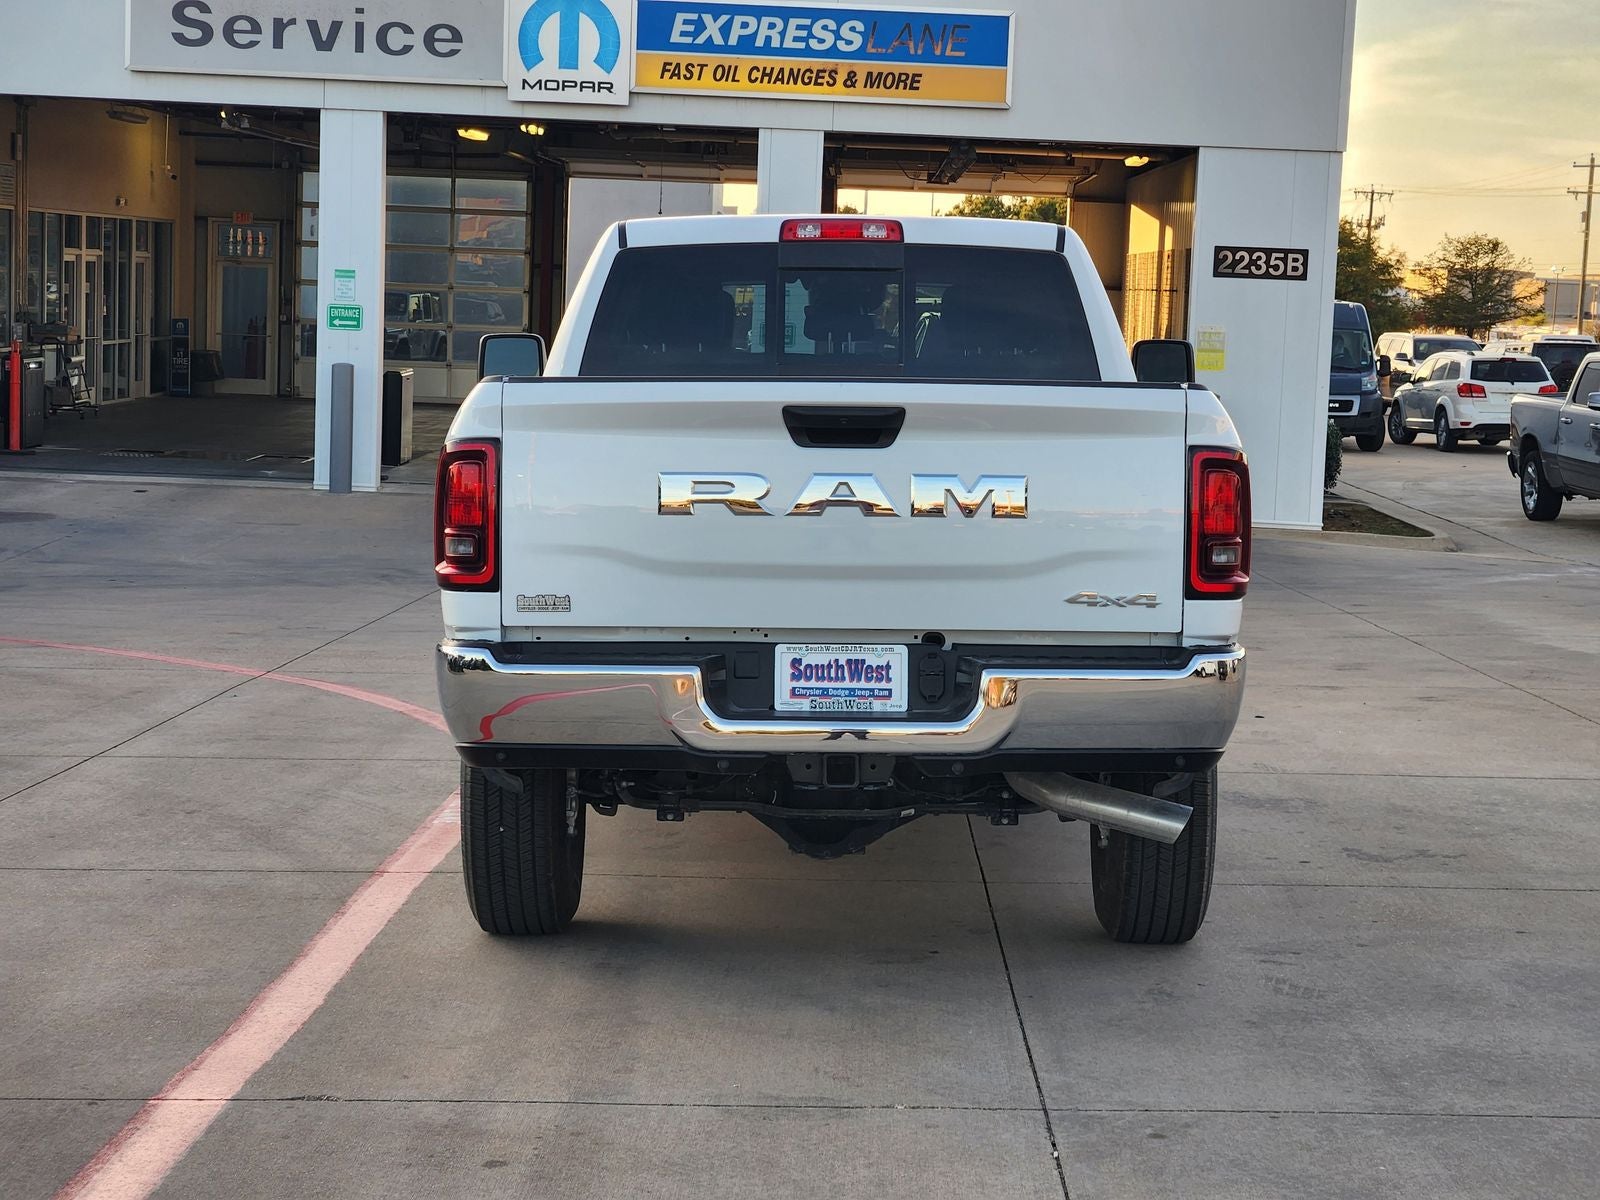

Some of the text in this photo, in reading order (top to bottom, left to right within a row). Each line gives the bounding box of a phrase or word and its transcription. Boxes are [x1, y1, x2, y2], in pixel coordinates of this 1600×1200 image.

[171, 0, 463, 58] Service
[521, 78, 614, 94] MOPAR
[659, 62, 922, 91] FAST OIL CHANGES & MORE
[1217, 250, 1304, 276] 2235B
[331, 308, 359, 318] ENTRANCE
[657, 471, 1029, 519] RAM
[790, 658, 892, 683] SouthWest
[795, 687, 822, 697] Chrysler
[829, 688, 849, 697] Dodge
[855, 689, 869, 697] Jeep
[810, 699, 873, 710] SouthWest
